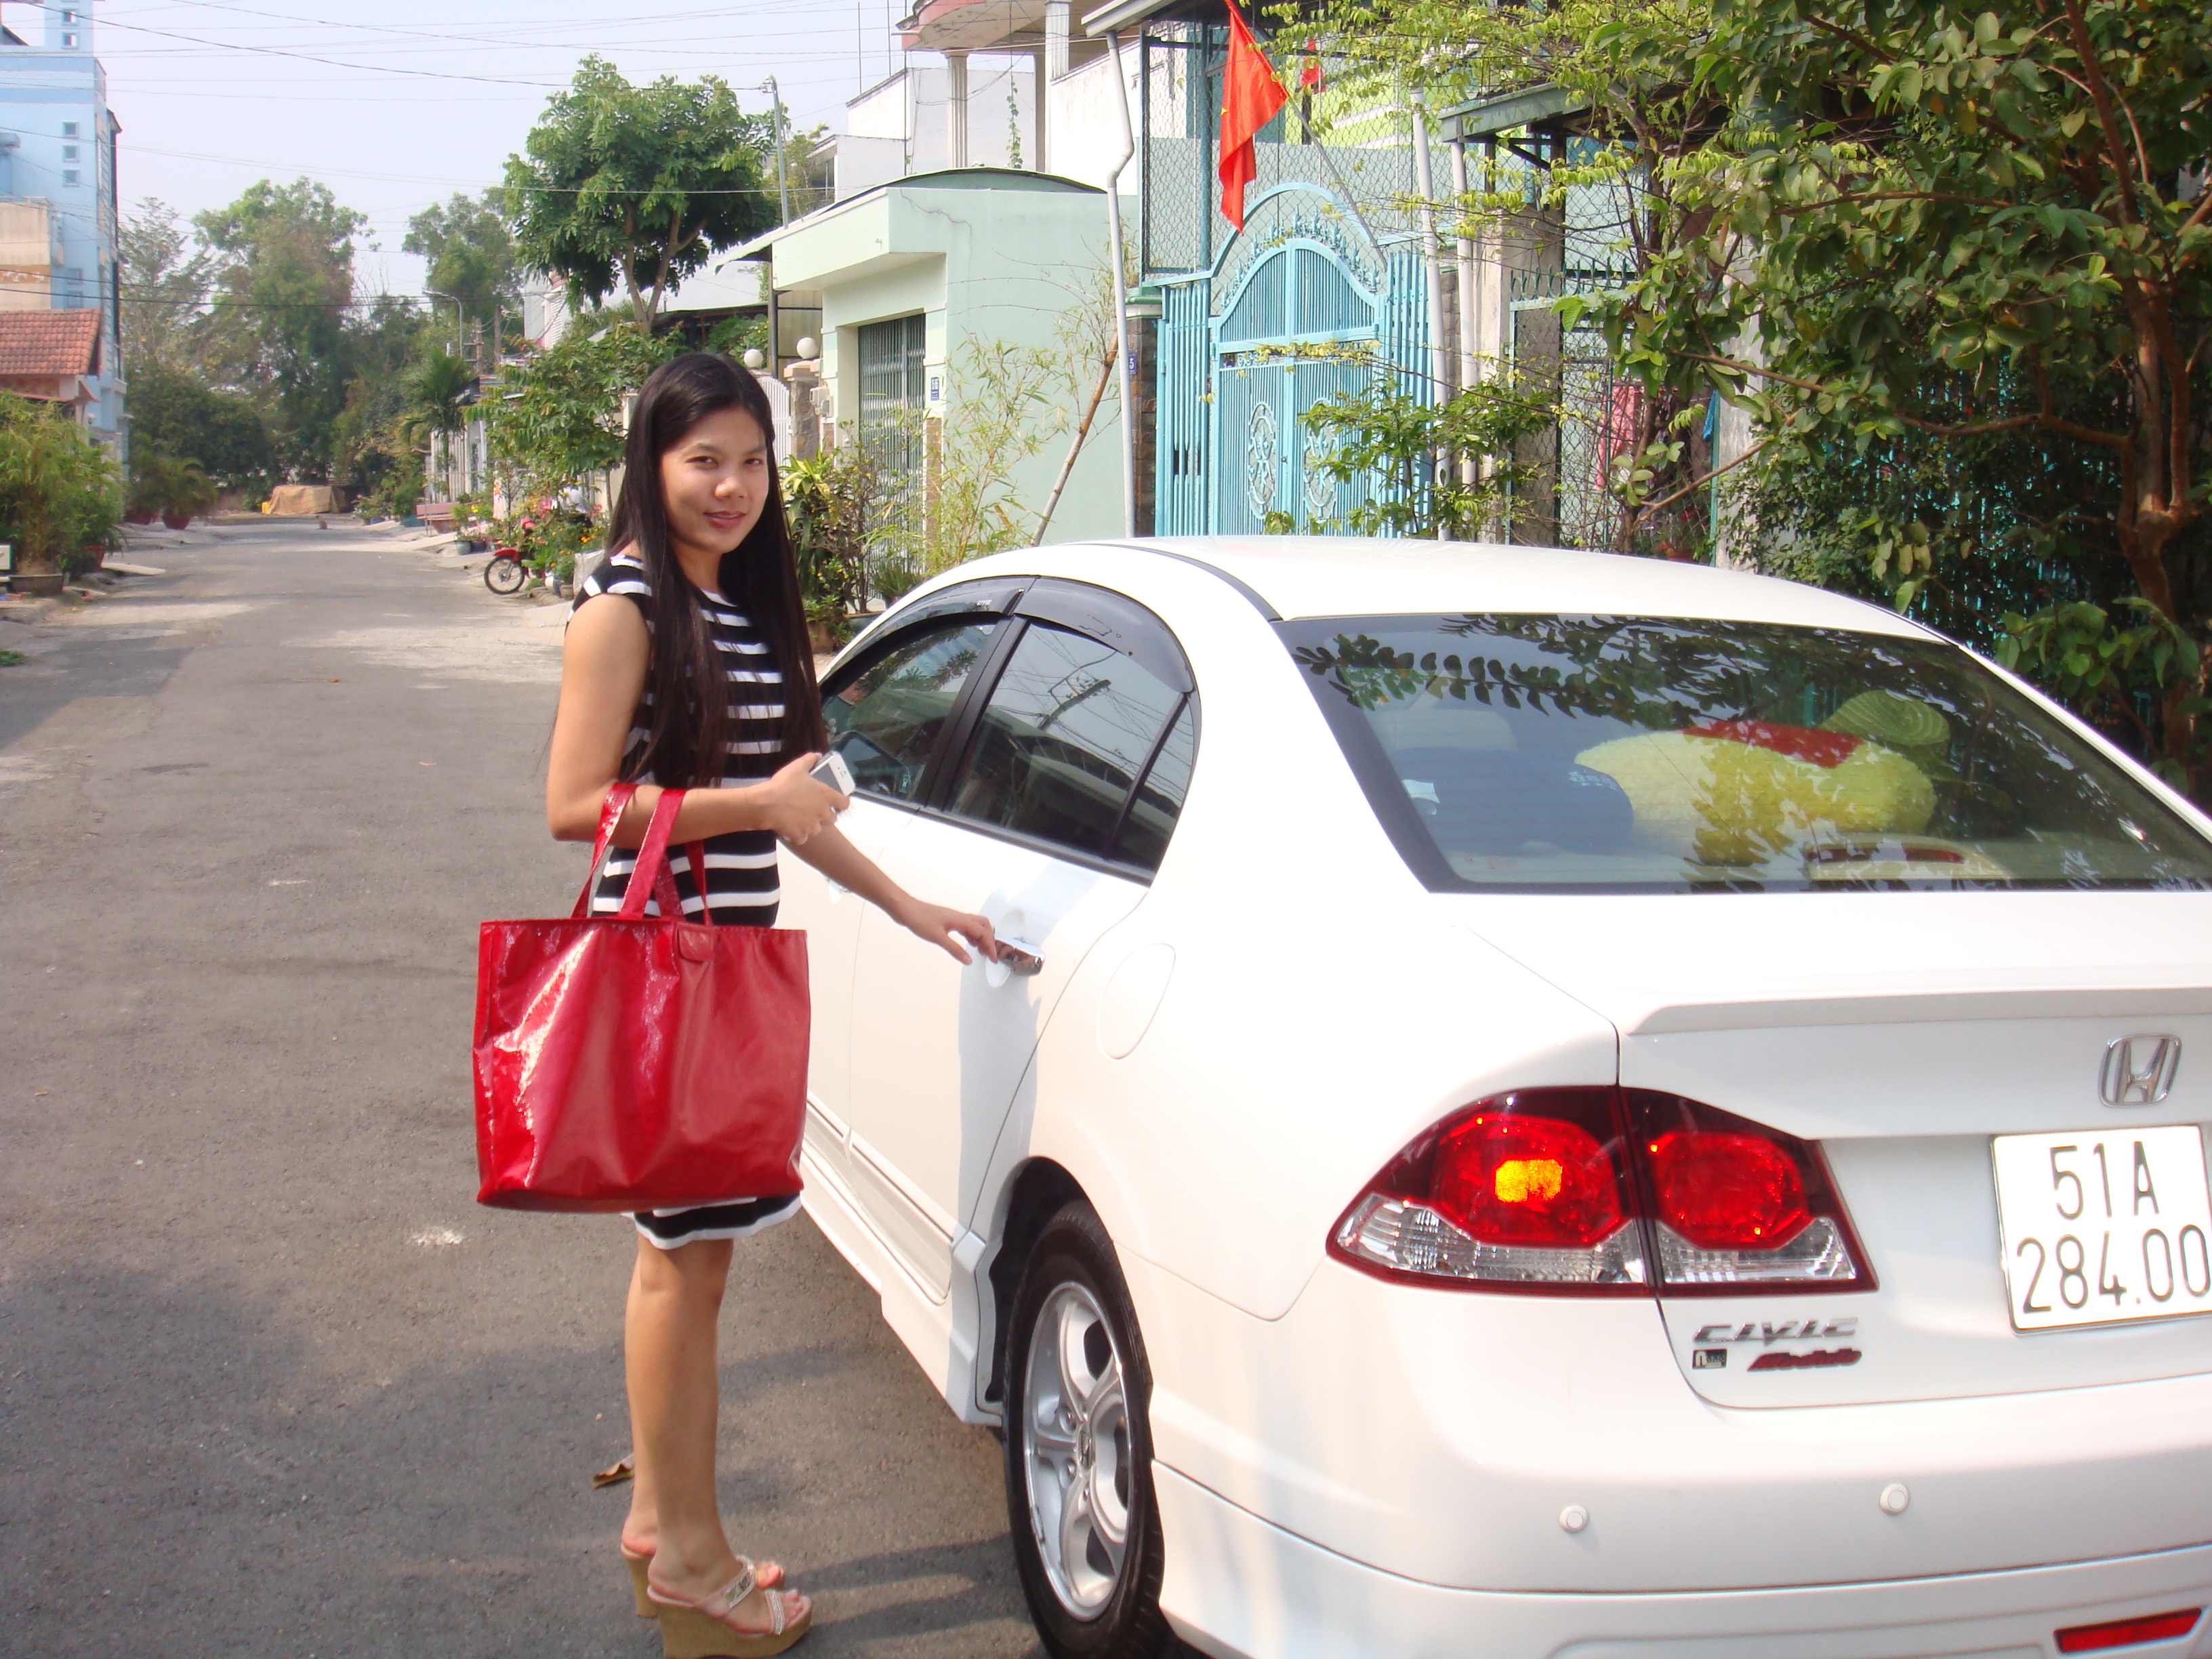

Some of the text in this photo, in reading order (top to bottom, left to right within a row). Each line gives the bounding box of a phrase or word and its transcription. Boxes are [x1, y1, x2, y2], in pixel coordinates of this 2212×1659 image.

[2049, 1141, 2160, 1221] 51A
[2016, 1224, 2211, 1314] 284.00
[1692, 1317, 1858, 1347] CIVIC
